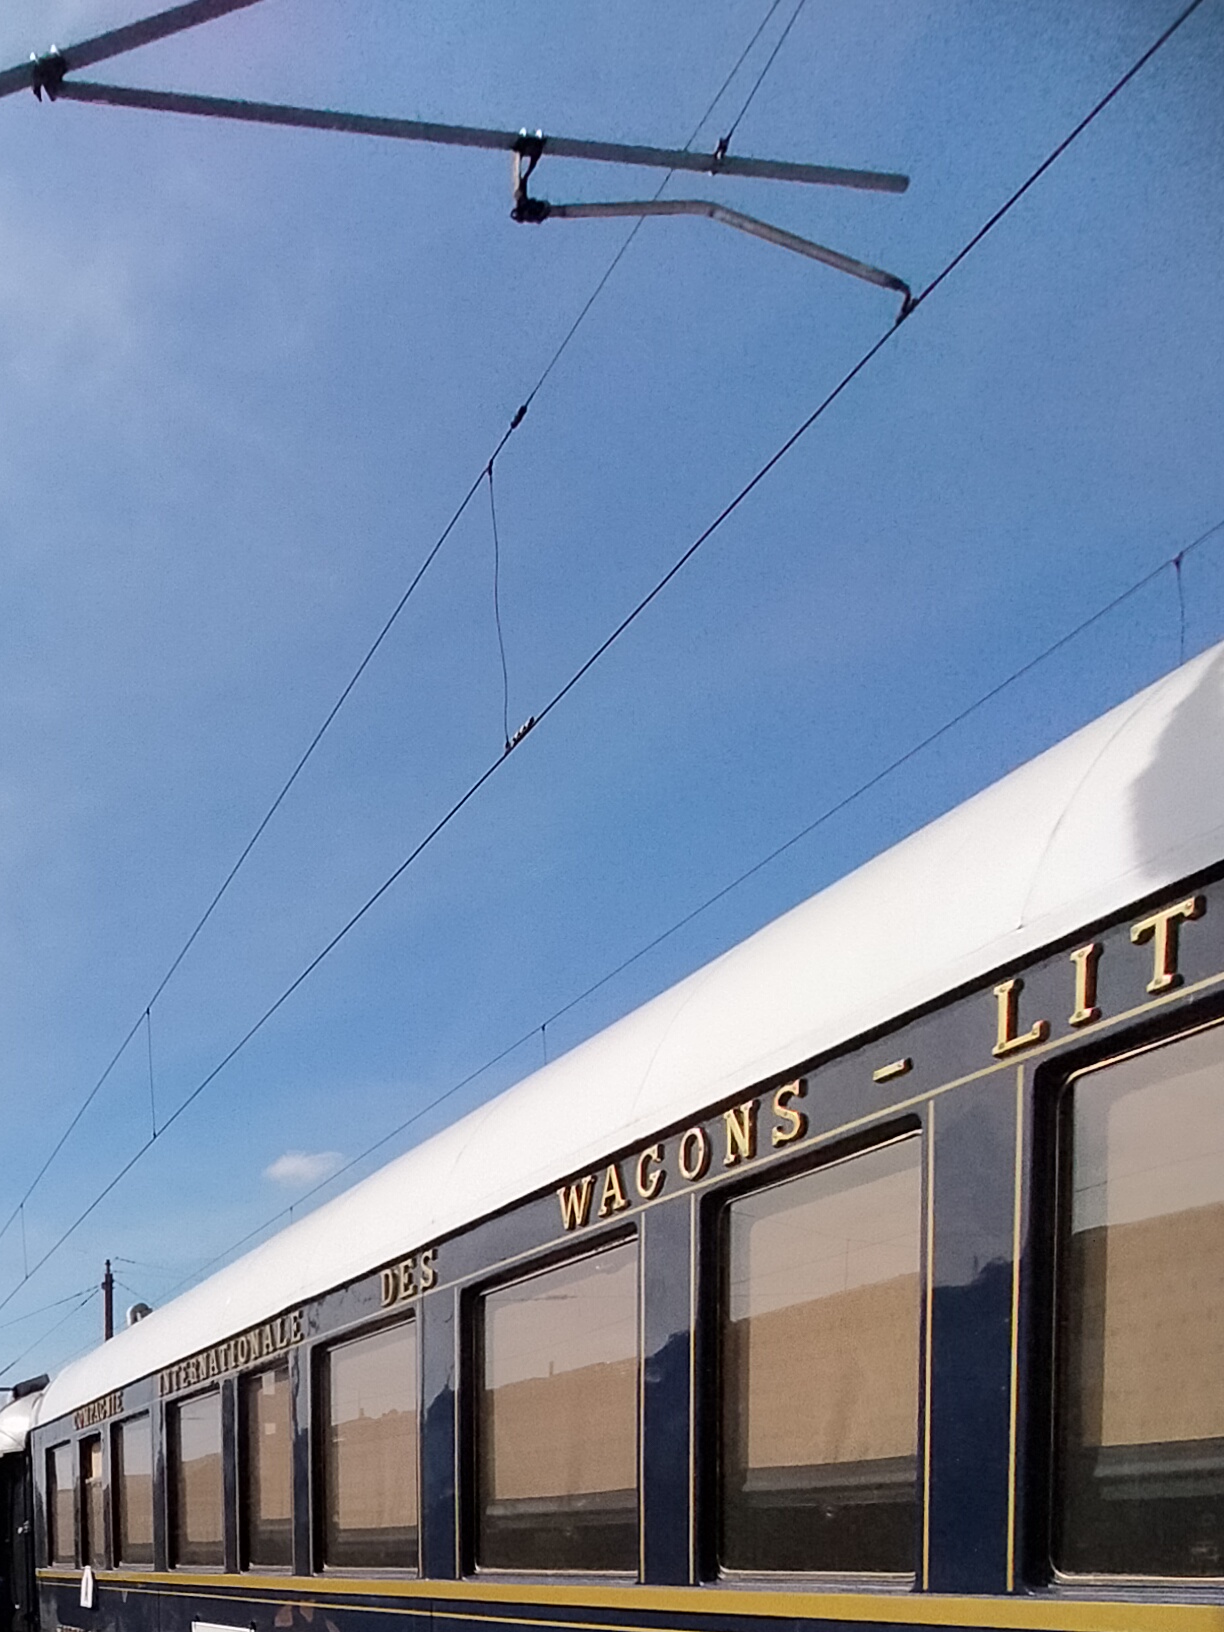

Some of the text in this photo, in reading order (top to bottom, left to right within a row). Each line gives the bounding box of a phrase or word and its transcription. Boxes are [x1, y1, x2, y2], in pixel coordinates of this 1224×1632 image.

[158, 1309, 304, 1398] INTERNATIONALE
[380, 1248, 437, 1308] DES
[556, 1077, 807, 1231] WAGONS
[992, 894, 1207, 1057] LIT
